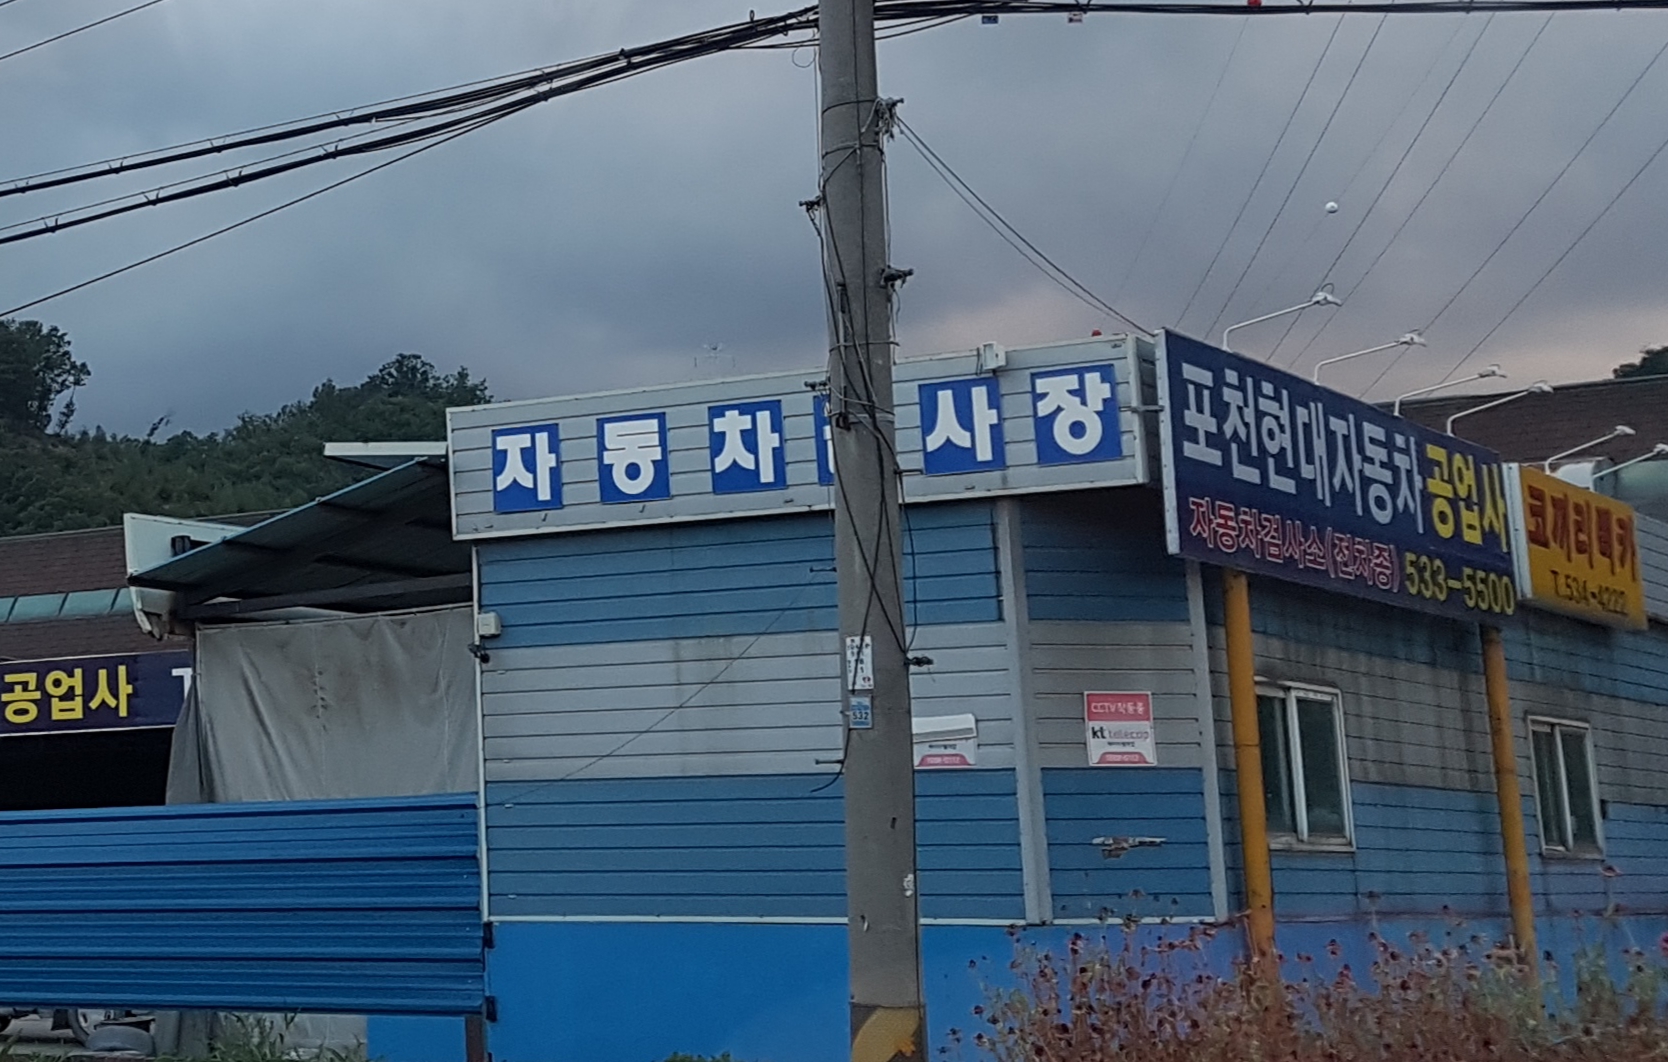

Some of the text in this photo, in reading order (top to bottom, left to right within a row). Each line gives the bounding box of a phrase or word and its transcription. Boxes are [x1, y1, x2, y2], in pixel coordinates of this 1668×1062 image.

[495, 372, 1112, 501] 자동차사장
[1182, 363, 1508, 553] 포천현대자동차 공업사
[1404, 553, 1515, 616] 533-5500
[0, 664, 133, 724] 공업사
[1092, 726, 1106, 739] kt
